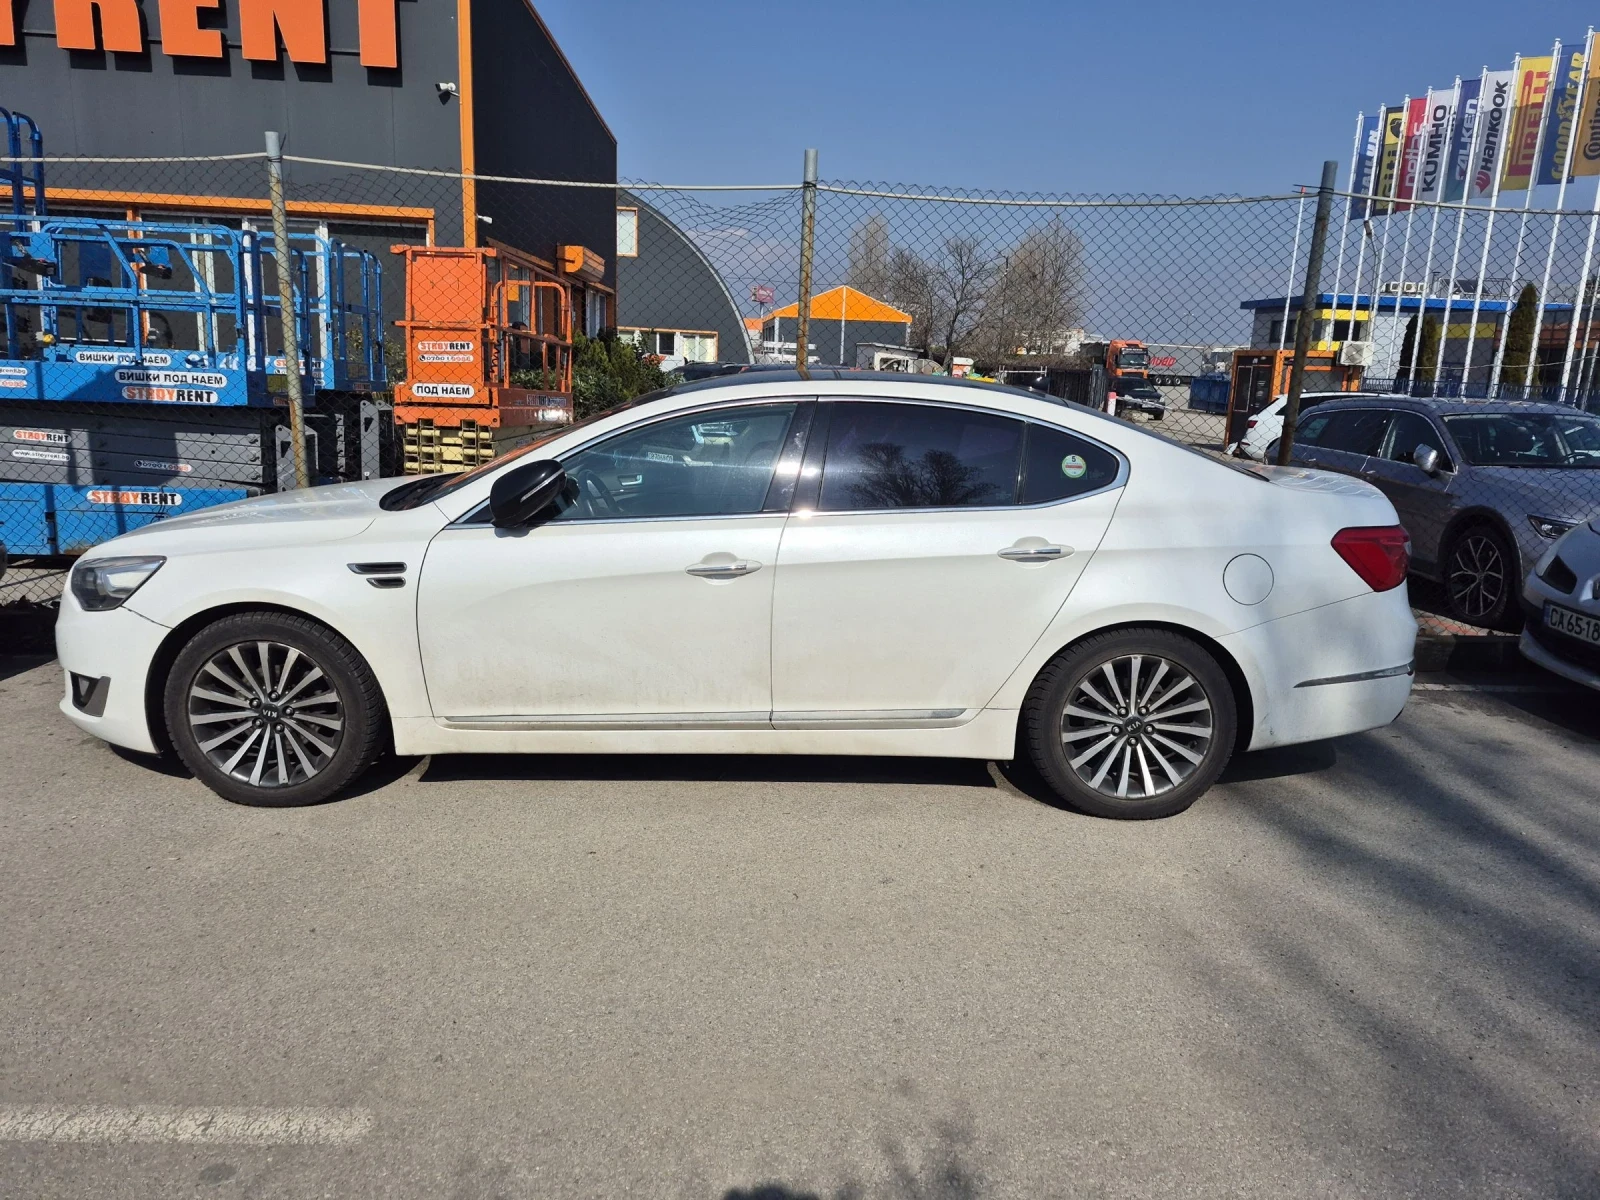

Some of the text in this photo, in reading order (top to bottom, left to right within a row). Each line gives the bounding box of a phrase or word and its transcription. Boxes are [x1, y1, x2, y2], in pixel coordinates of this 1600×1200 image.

[1422, 104, 1447, 192] KUMHO
[421, 342, 470, 350] STROYRENT
[79, 353, 115, 362] ВИШКИ
[119, 372, 224, 385] ВИШКИ ПОД НАЕМ
[125, 386, 213, 403] STROYRENT
[416, 385, 470, 395] ПОД НАЕМ
[15, 431, 69, 442] STROYRENT
[92, 491, 177, 505] STROYRENT
[1126, 721, 1142, 732] KIA
